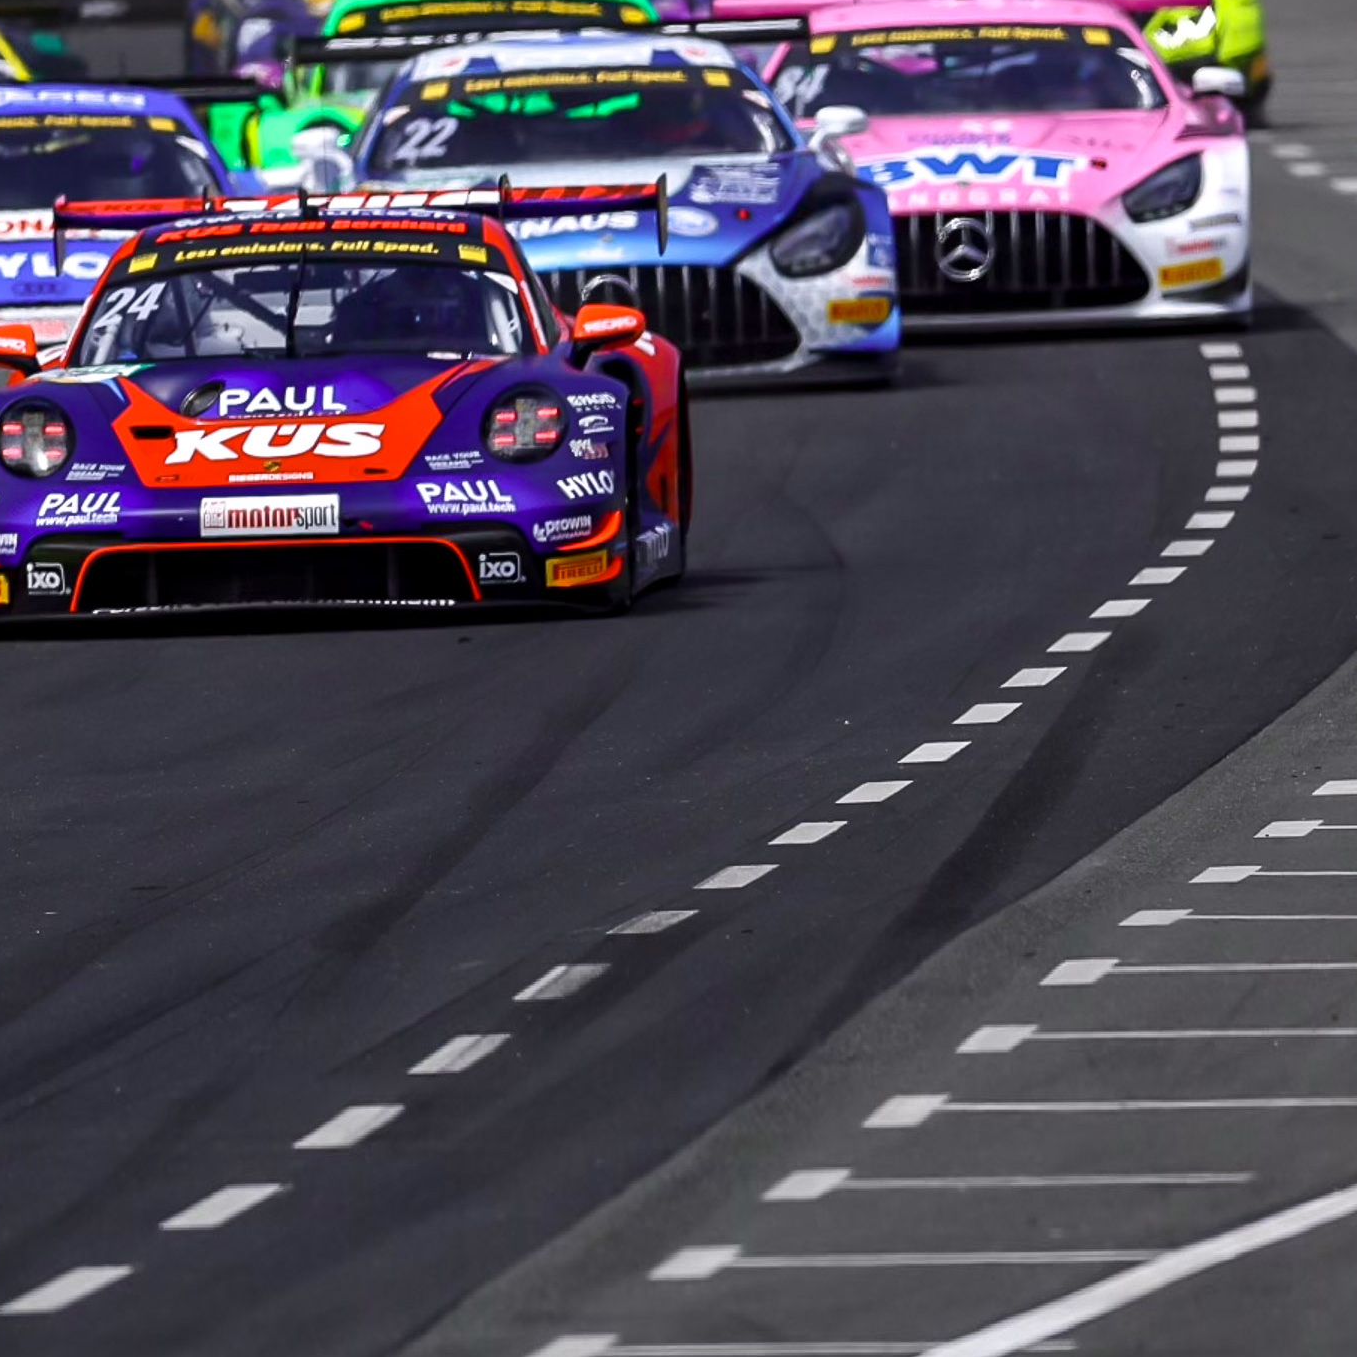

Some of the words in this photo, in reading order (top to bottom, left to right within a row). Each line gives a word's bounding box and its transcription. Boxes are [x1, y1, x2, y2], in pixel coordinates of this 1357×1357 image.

[393, 117, 459, 162] 22
[856, 152, 1076, 184] BWT
[93, 282, 167, 330] 24
[219, 386, 347, 416] PAUL
[416, 479, 513, 503] PAUL
[556, 470, 614, 500] HYLO
[38, 491, 121, 517] PAUL
[227, 503, 336, 530] motorsport
[427, 501, 516, 516] www.paul.tech
[36, 512, 119, 528] www.paul.tech
[26, 562, 61, 589] ixo
[479, 553, 517, 579] ixo
